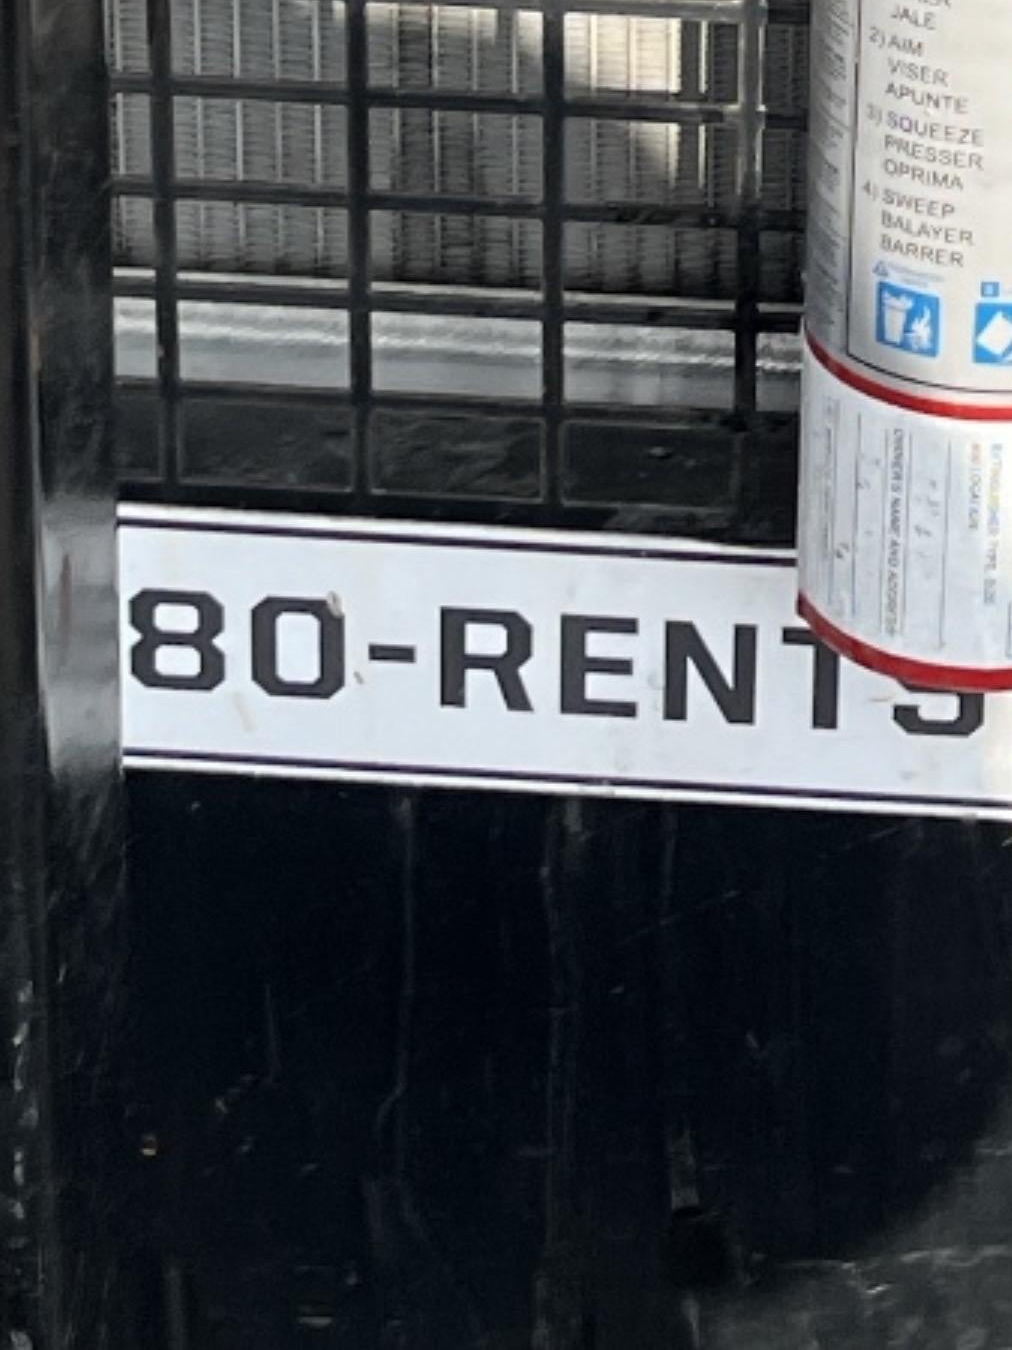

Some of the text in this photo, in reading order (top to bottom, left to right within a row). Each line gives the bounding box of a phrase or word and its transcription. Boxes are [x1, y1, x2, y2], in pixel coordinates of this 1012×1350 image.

[887, 34, 922, 57] AIM
[887, 57, 949, 87] VISER
[884, 82, 969, 114] APUNTE
[886, 110, 985, 148] SQUEEZE
[884, 134, 984, 171] PRESSER
[883, 157, 964, 194] OPRIMA
[881, 188, 955, 219] SWEEP
[880, 209, 974, 246] BALAYER
[879, 233, 965, 268] BARRER
